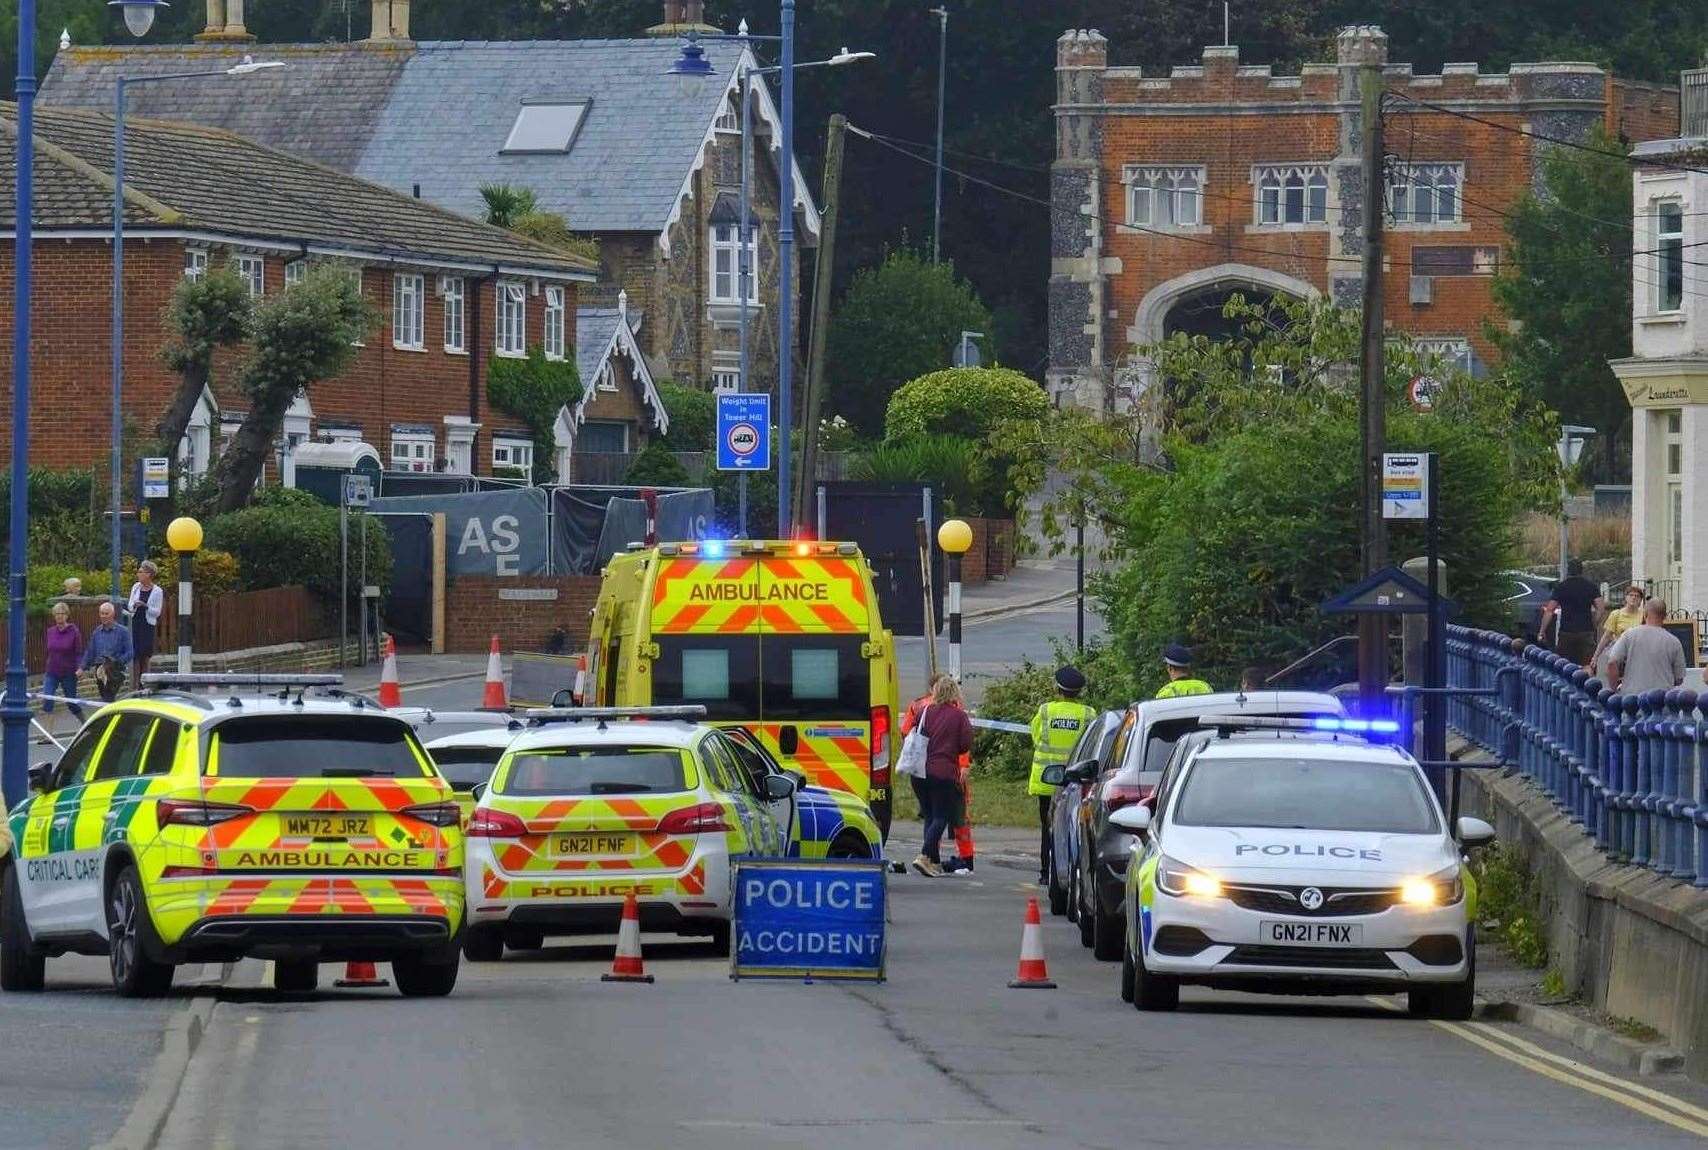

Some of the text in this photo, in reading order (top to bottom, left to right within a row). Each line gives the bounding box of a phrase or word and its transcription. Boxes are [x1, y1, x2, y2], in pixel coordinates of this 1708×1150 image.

[721, 397, 748, 406] Weight
[458, 515, 521, 555] AS
[689, 583, 829, 601] AMBULANCE
[1052, 719, 1079, 730] POLICE
[287, 819, 370, 835] MM72 JRZ
[559, 837, 626, 853] GN21 FNF
[1235, 844, 1383, 862] POLICE
[236, 852, 419, 867] AMBULANCE
[27, 859, 72, 881] CRITICAL
[531, 885, 655, 897] POLICE
[745, 879, 874, 909] POLICE
[1272, 923, 1352, 943] GN21 FNX
[738, 931, 881, 955] ACCIDENT
